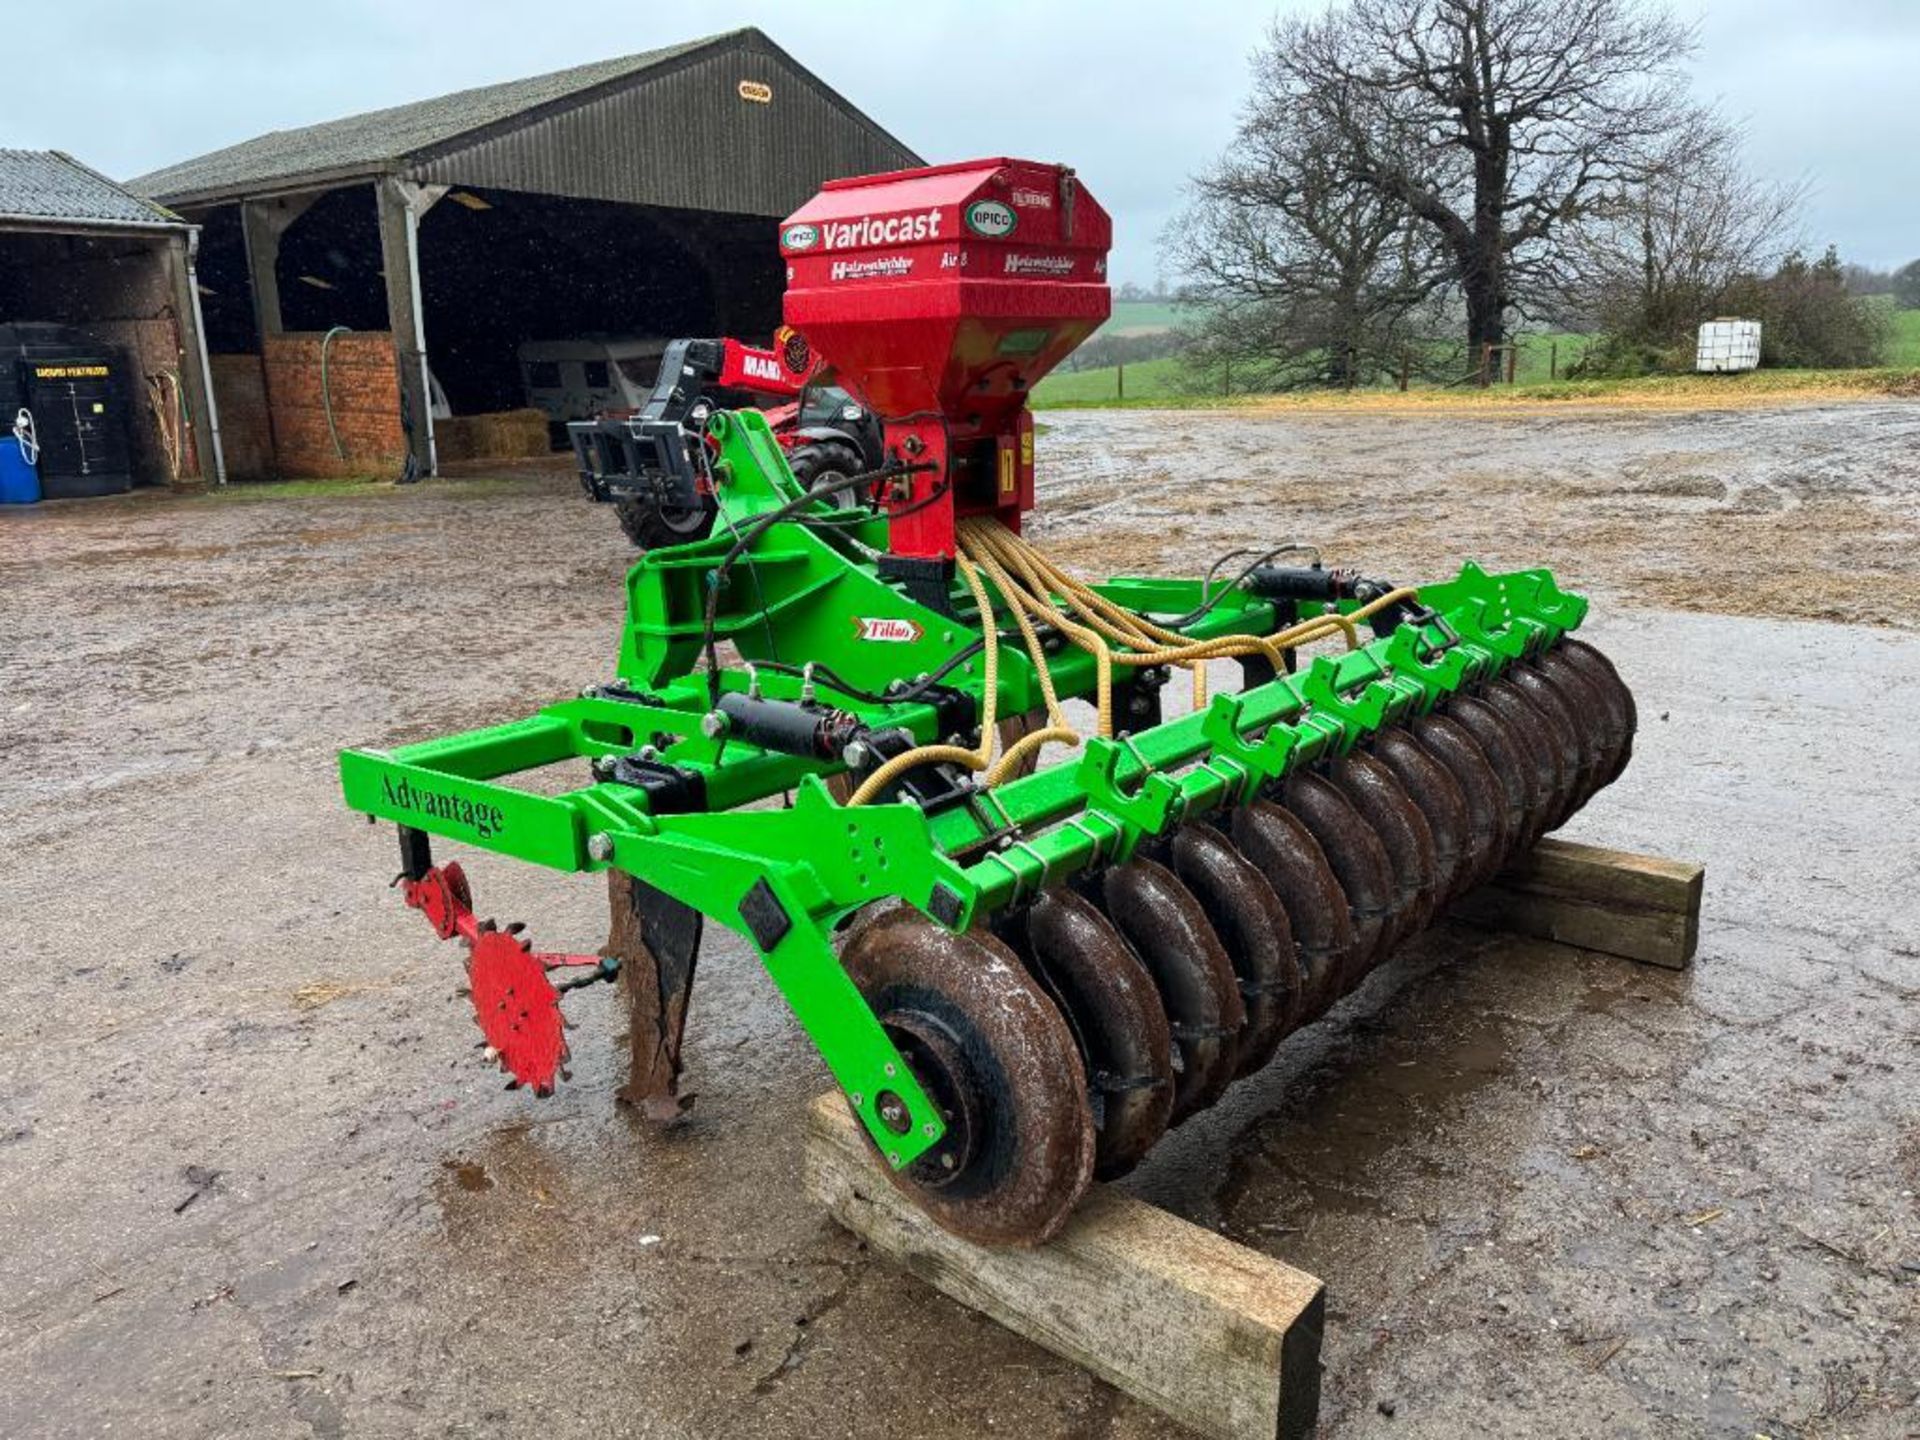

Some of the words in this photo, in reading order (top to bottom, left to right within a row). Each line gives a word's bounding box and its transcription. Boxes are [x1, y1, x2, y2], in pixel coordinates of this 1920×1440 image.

[823, 208, 942, 250] Variocast
[974, 211, 1010, 226] OPICO
[940, 252, 957, 269] Air
[743, 355, 786, 382] MAN
[382, 771, 503, 839] Advantage
